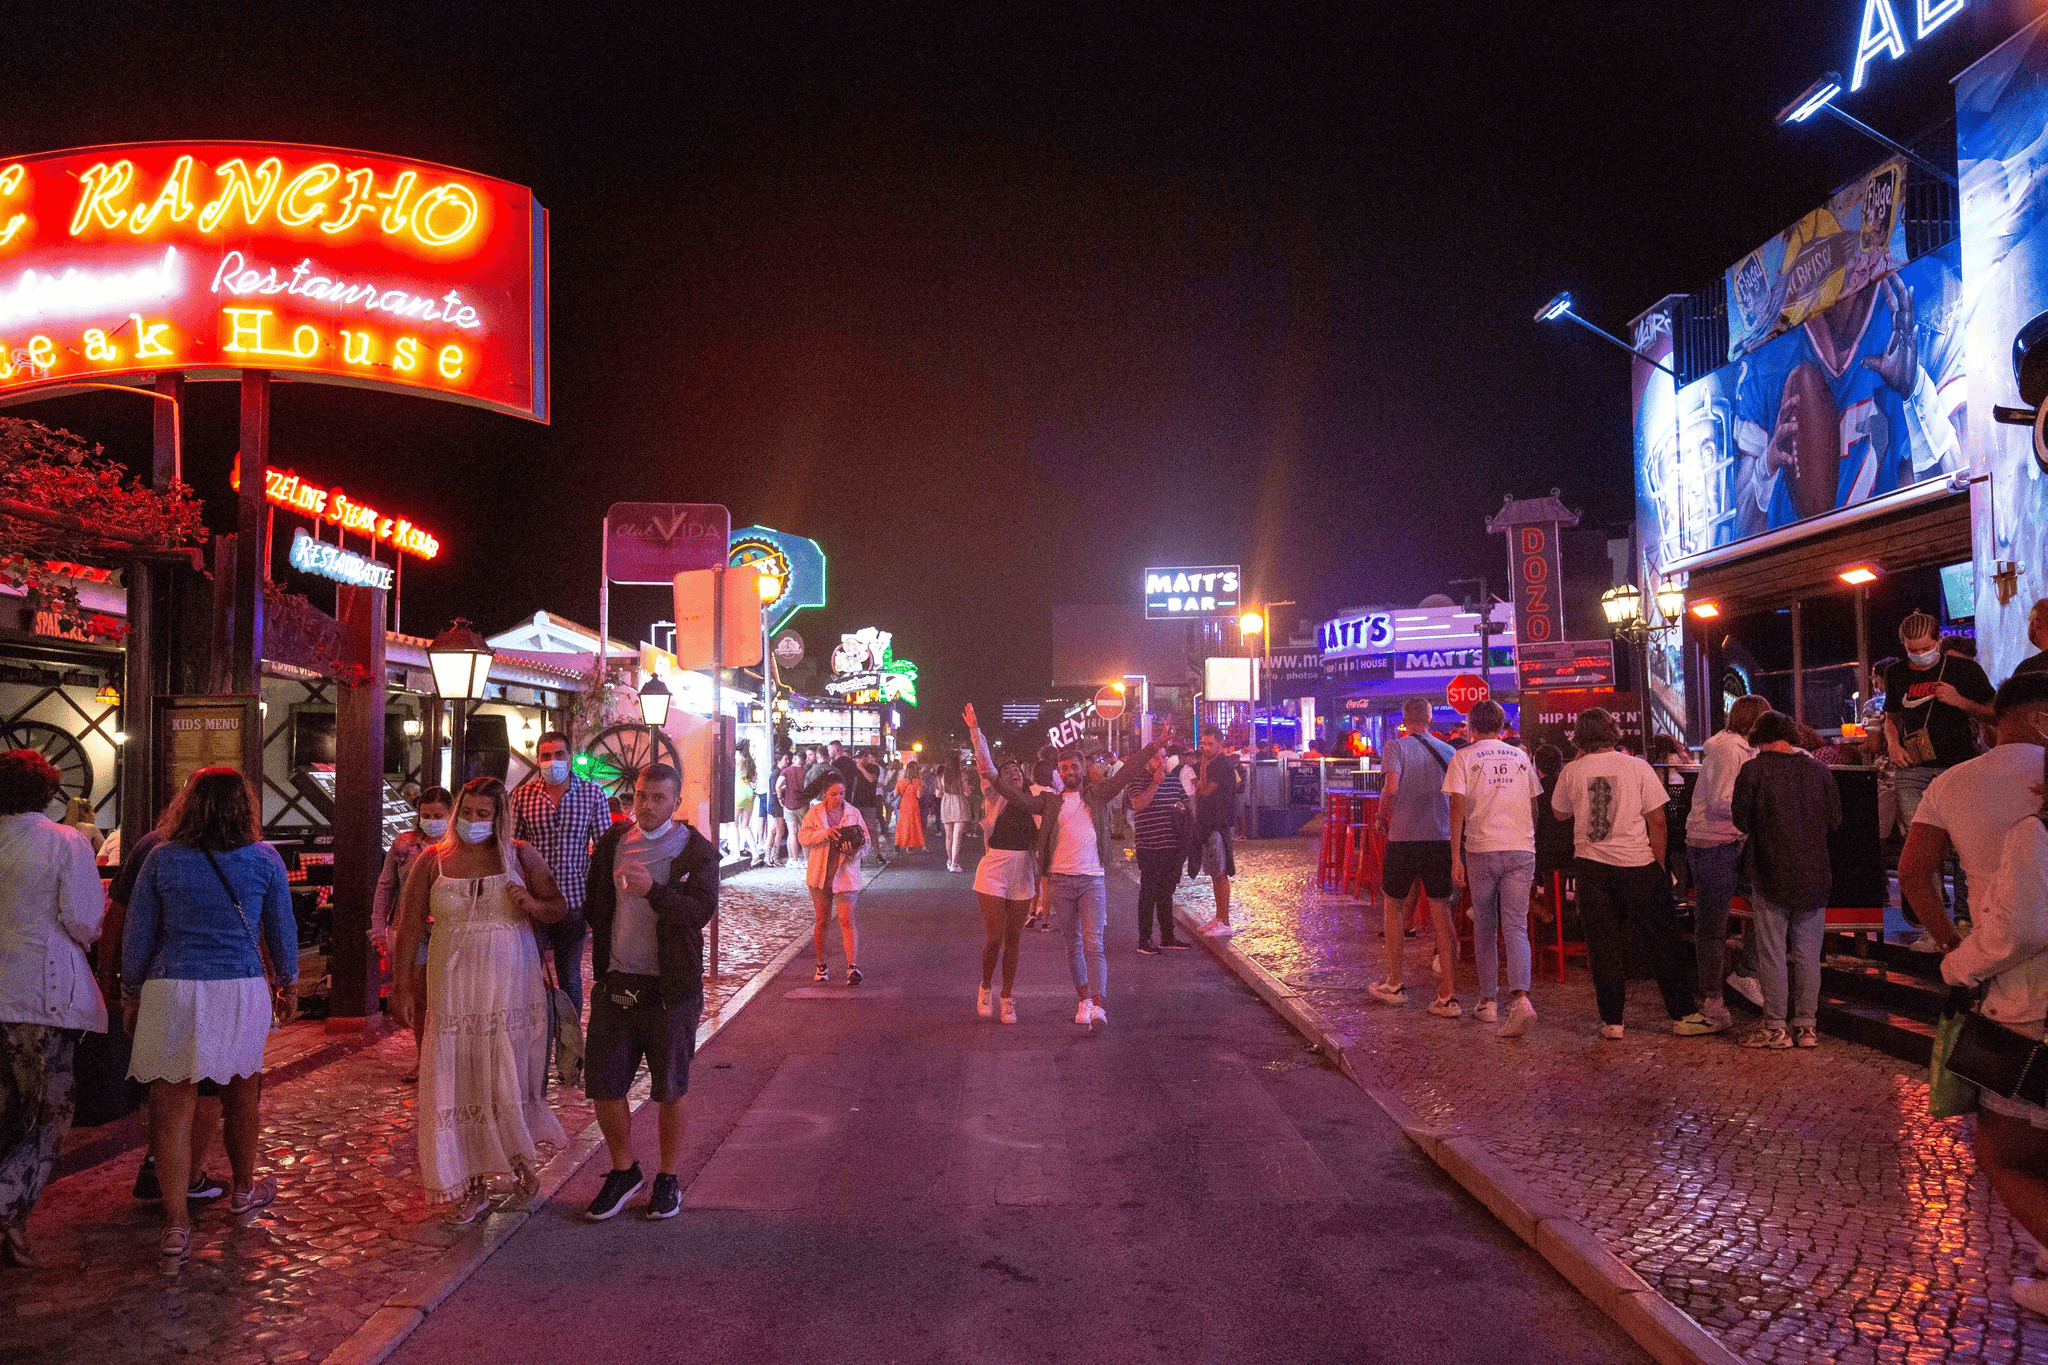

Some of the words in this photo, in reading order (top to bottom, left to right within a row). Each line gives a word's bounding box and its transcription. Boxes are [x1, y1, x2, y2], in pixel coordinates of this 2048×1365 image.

[70, 155, 478, 246] RANCHO
[211, 250, 480, 328] Restaurante
[223, 307, 466, 378] House
[653, 511, 721, 541] VIDA
[1146, 571, 1239, 594] MATT'S
[1522, 527, 1551, 641] DOZO
[1168, 596, 1216, 612] BAR
[1360, 657, 1388, 669] HOUSE
[1405, 648, 1483, 670] MATT'S
[1286, 672, 1319, 682] photos
[1449, 686, 1488, 702] STOP
[172, 718, 201, 731] KIDS
[205, 718, 239, 730] MENU
[1539, 712, 1564, 724] HIP
[1493, 763, 1508, 775] 16
